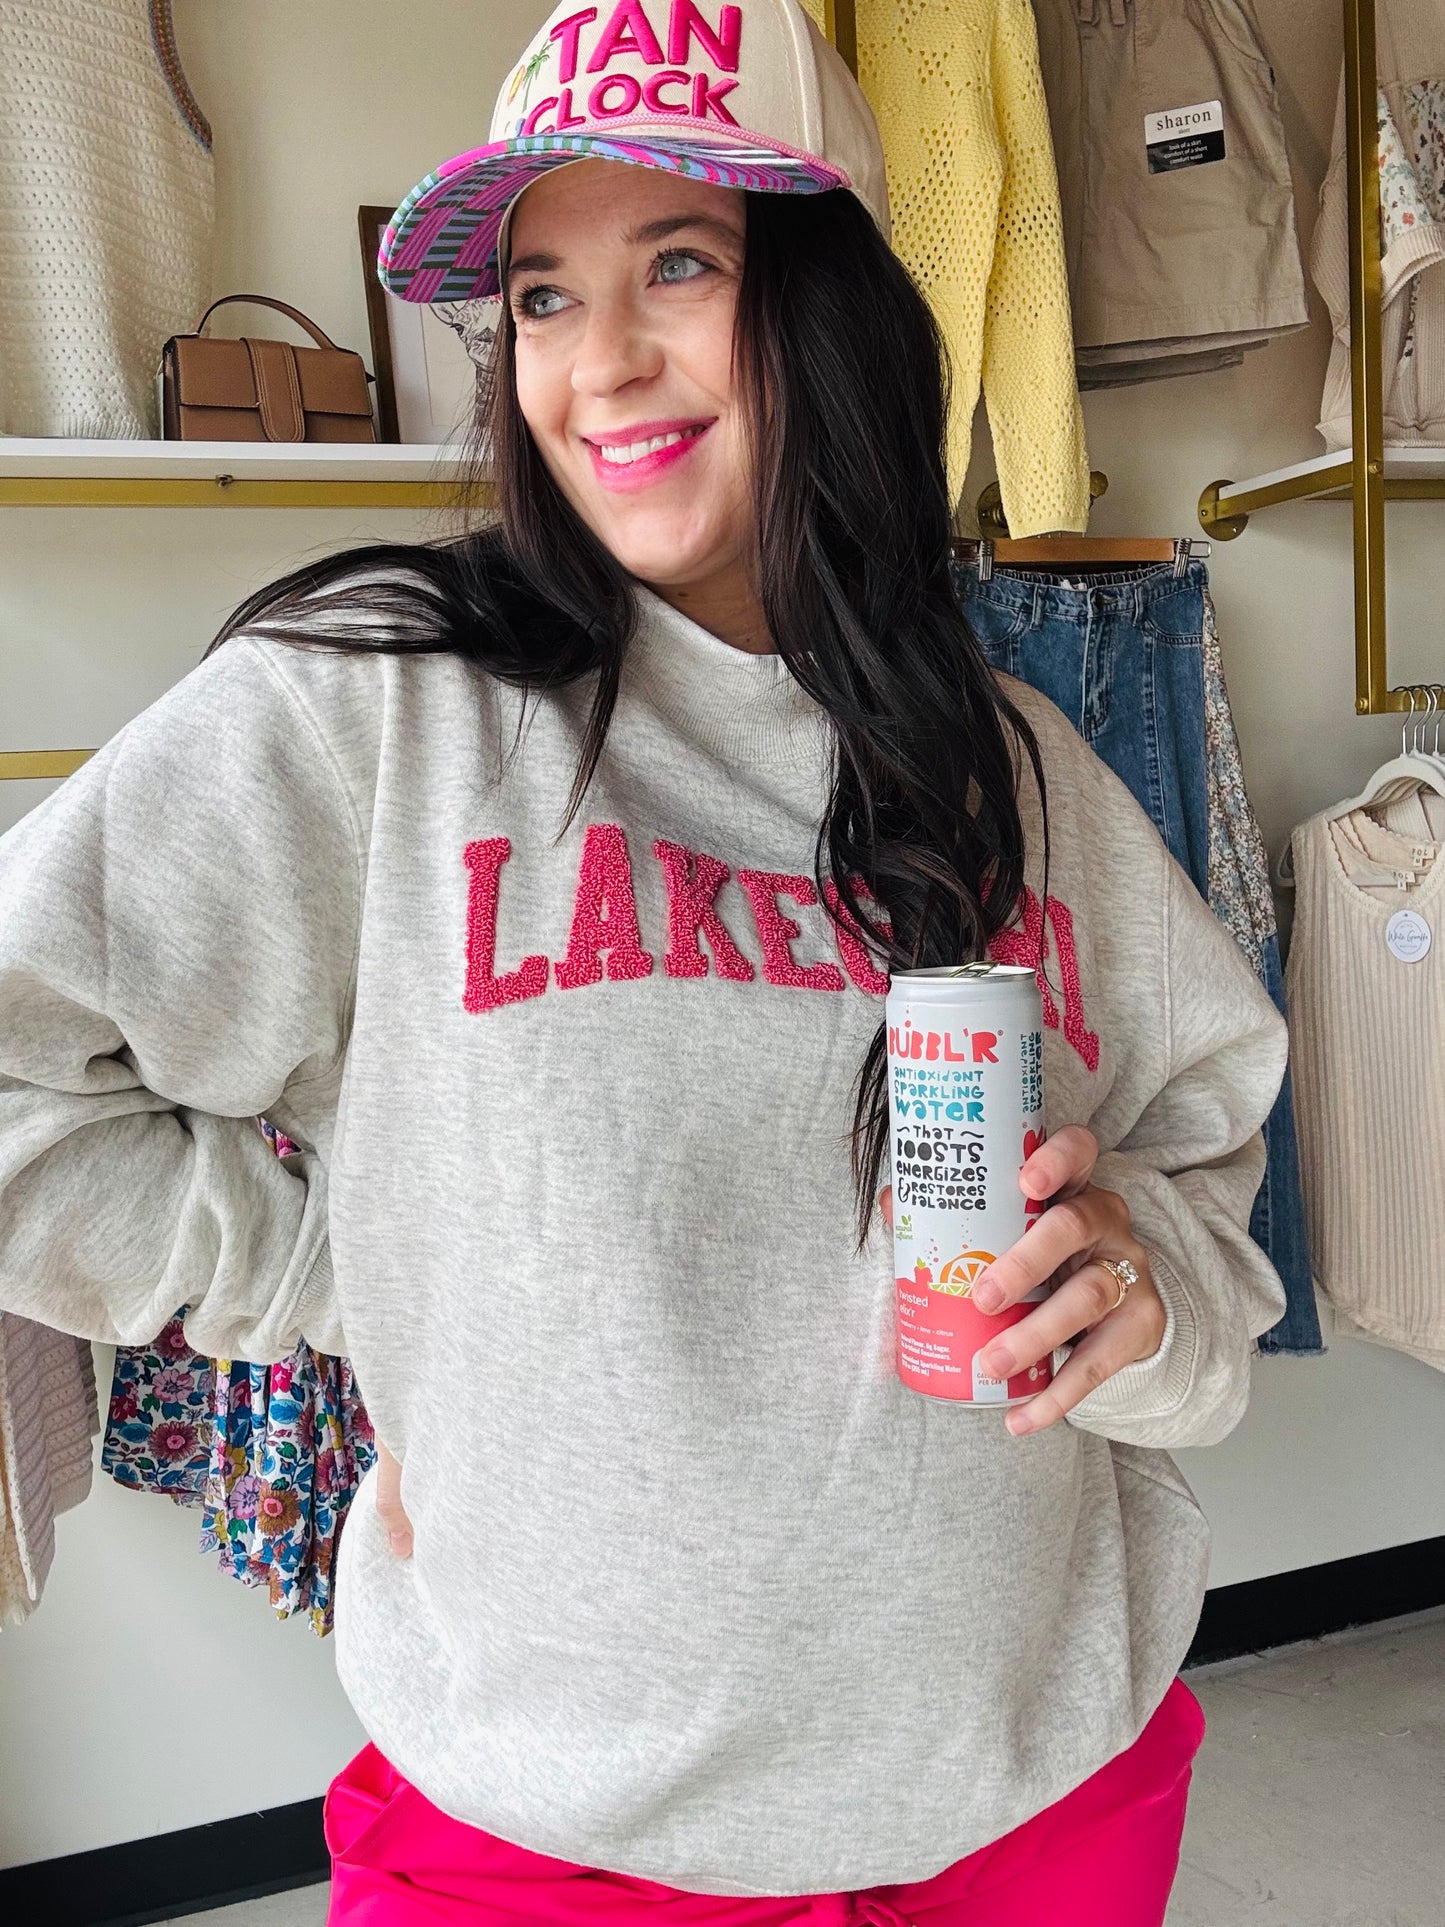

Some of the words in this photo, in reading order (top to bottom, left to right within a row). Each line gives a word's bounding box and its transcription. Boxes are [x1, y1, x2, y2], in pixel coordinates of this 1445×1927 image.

[550, 0, 742, 84] TAN
[520, 70, 739, 136] CLOCK
[1156, 110, 1212, 131] sharon
[897, 1138, 985, 1163] BOOSTS
